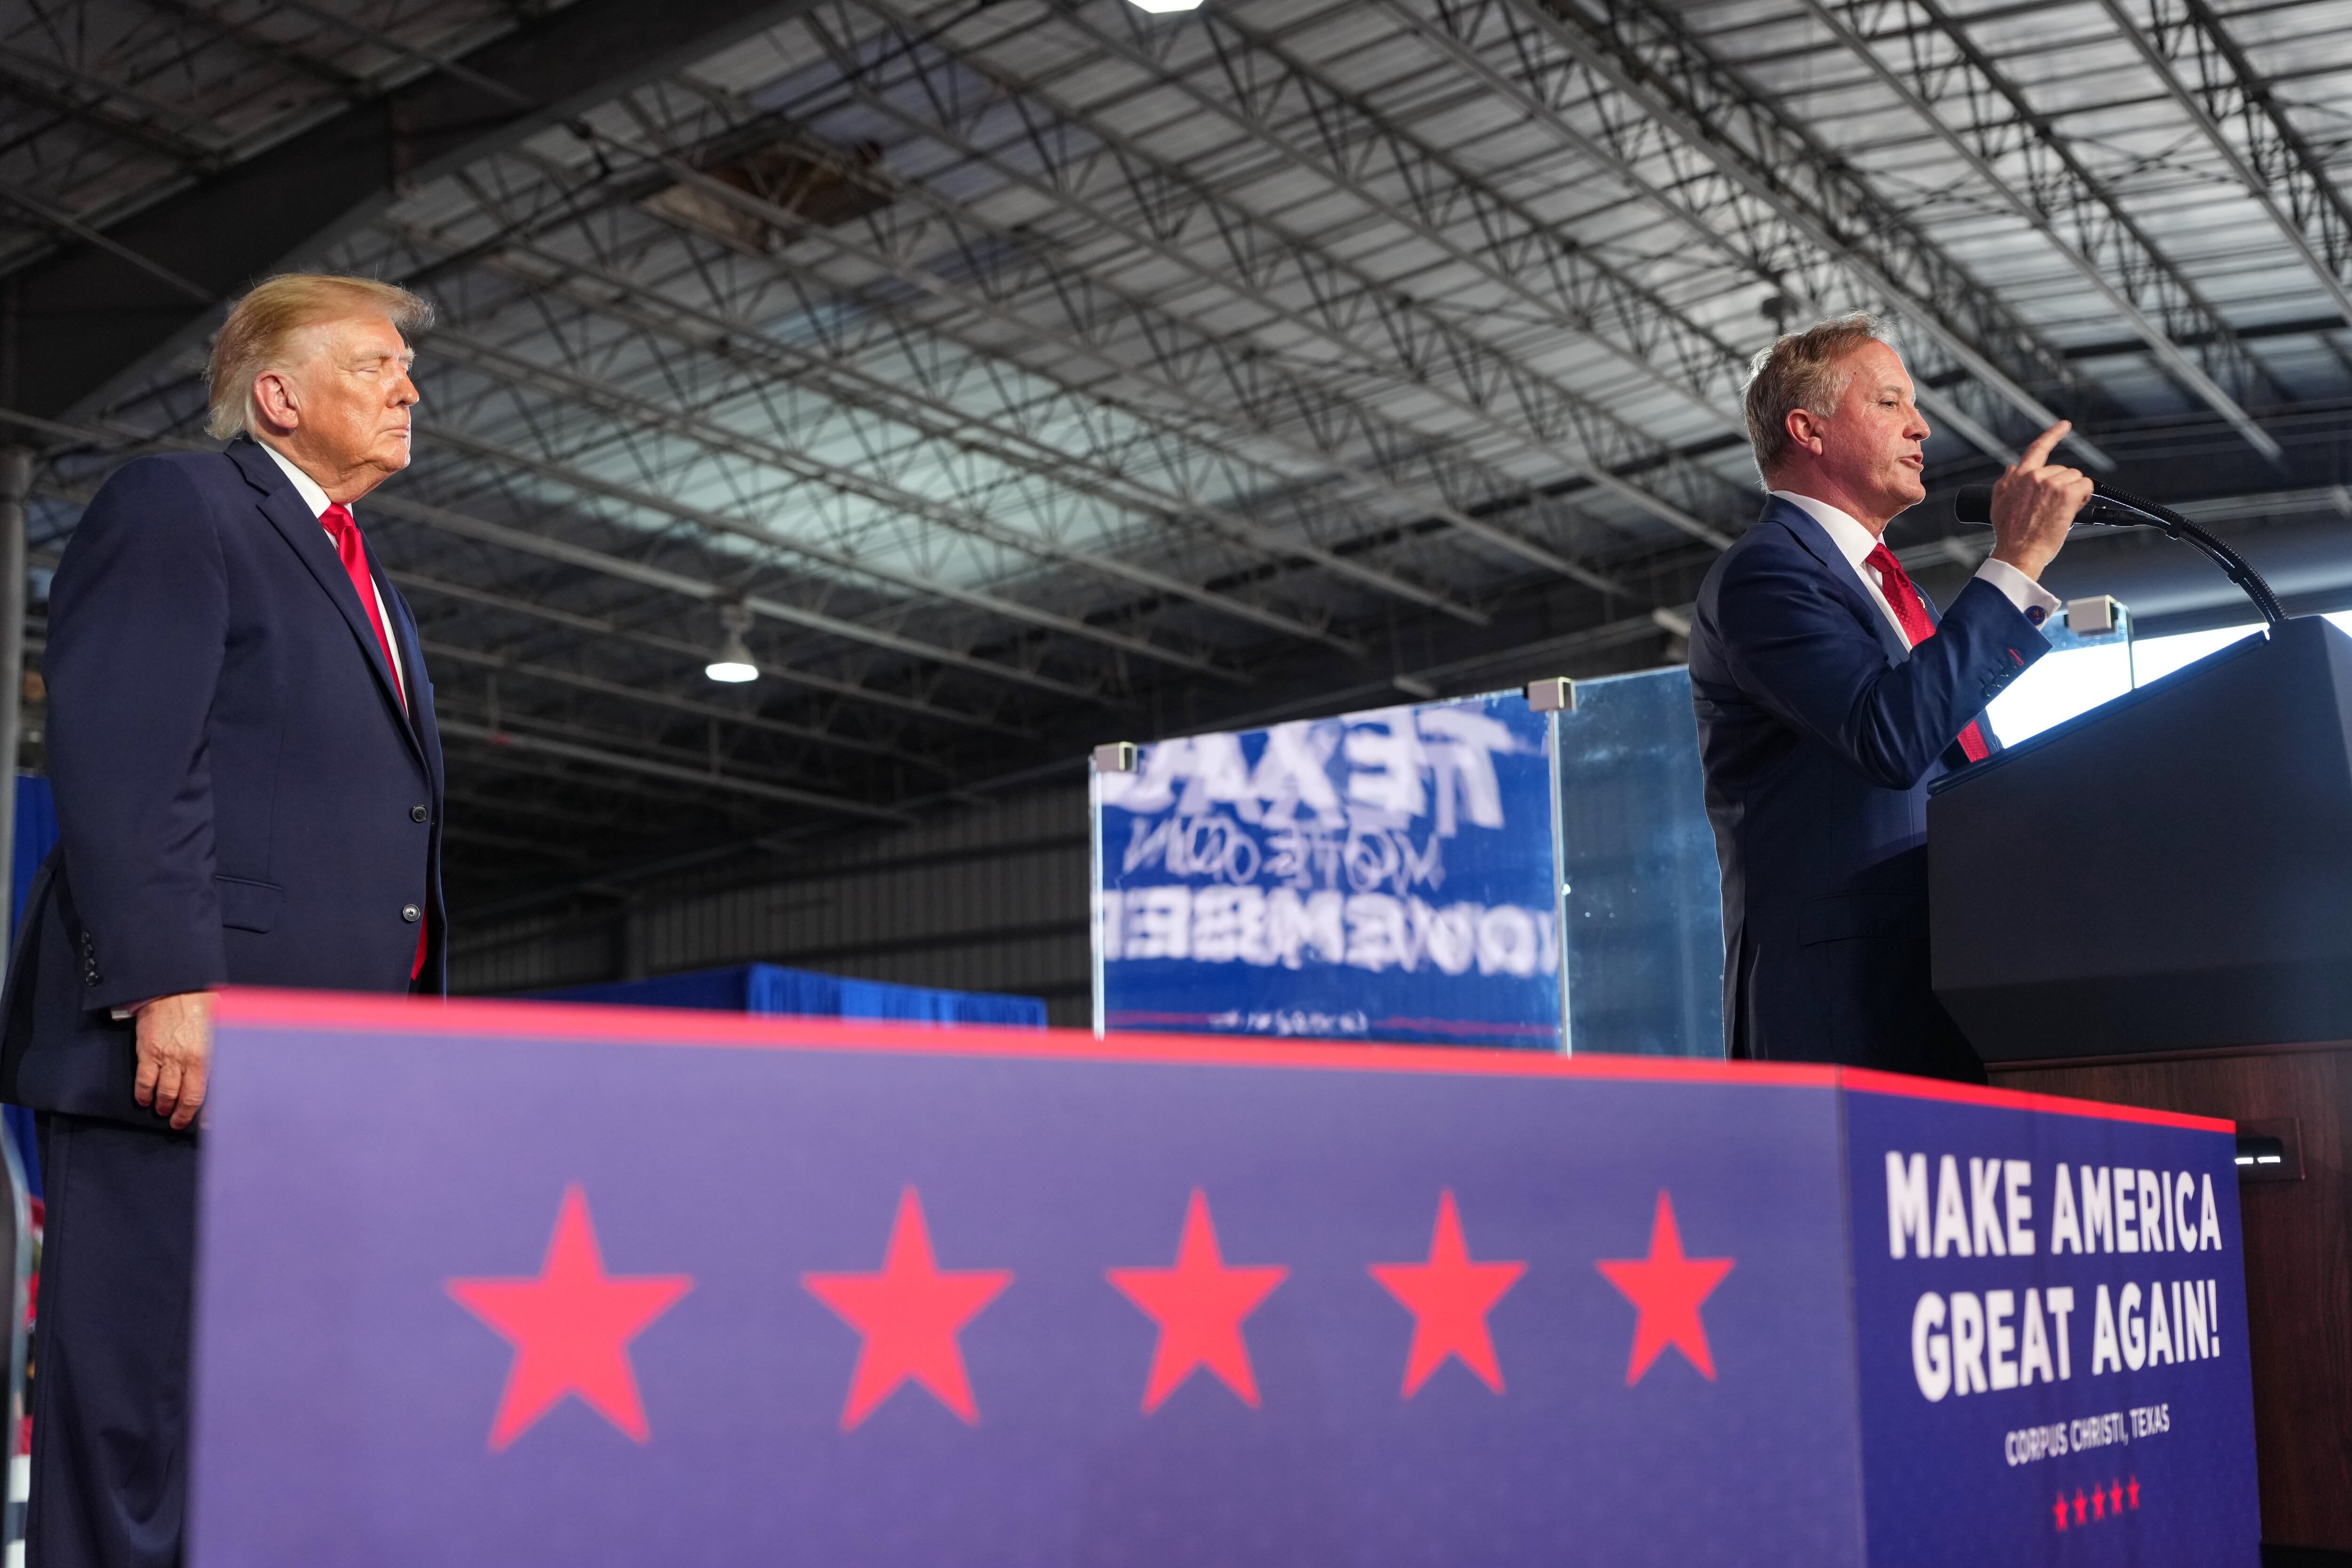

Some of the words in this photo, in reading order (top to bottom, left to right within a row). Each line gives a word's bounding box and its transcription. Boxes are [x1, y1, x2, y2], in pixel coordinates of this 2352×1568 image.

[1885, 1150, 2035, 1260] MAKE
[2050, 1162, 2222, 1255] AMERICA
[1911, 1286, 2074, 1402] GREAT
[2091, 1279, 2220, 1376] AGAIN!
[2005, 1422, 2068, 1466] CORPUS
[2070, 1411, 2129, 1453] CHRISTI,
[2129, 1403, 2170, 1439] TEXAS
